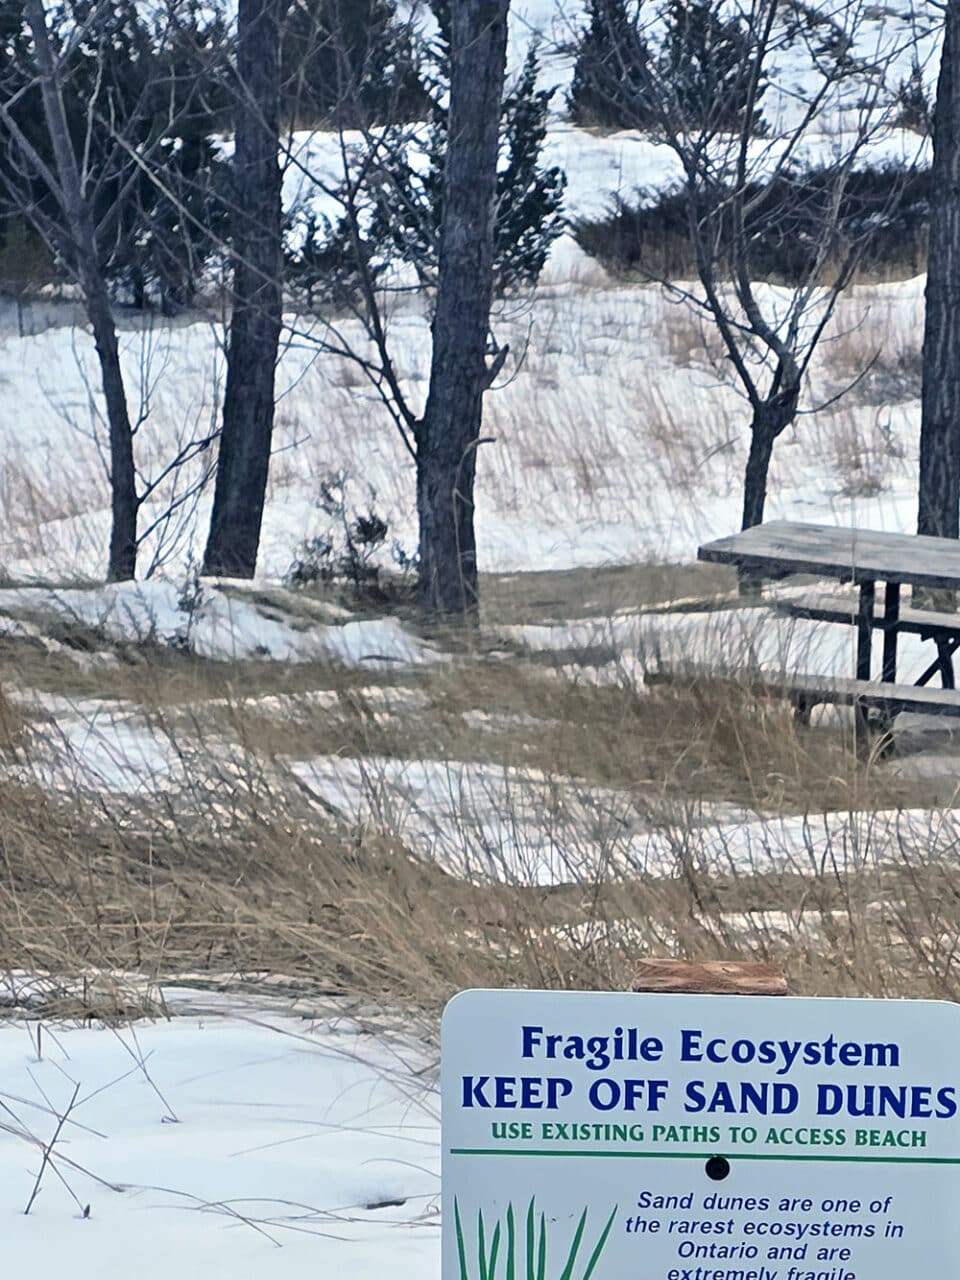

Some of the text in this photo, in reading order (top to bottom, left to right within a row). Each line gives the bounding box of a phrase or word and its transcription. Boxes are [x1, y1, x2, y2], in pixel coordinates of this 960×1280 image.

[522, 1026, 899, 1074] Fragile Ecosystem
[462, 1076, 957, 1118] KEEP OFF SAND DUNES
[492, 1123, 926, 1147] USE EXISTING PATHS TO ACCESS BEACH
[638, 1192, 892, 1213] Sand dunes are one of
[626, 1216, 903, 1240] the rarest ecosystems in
[678, 1241, 850, 1260] Ontario and are
